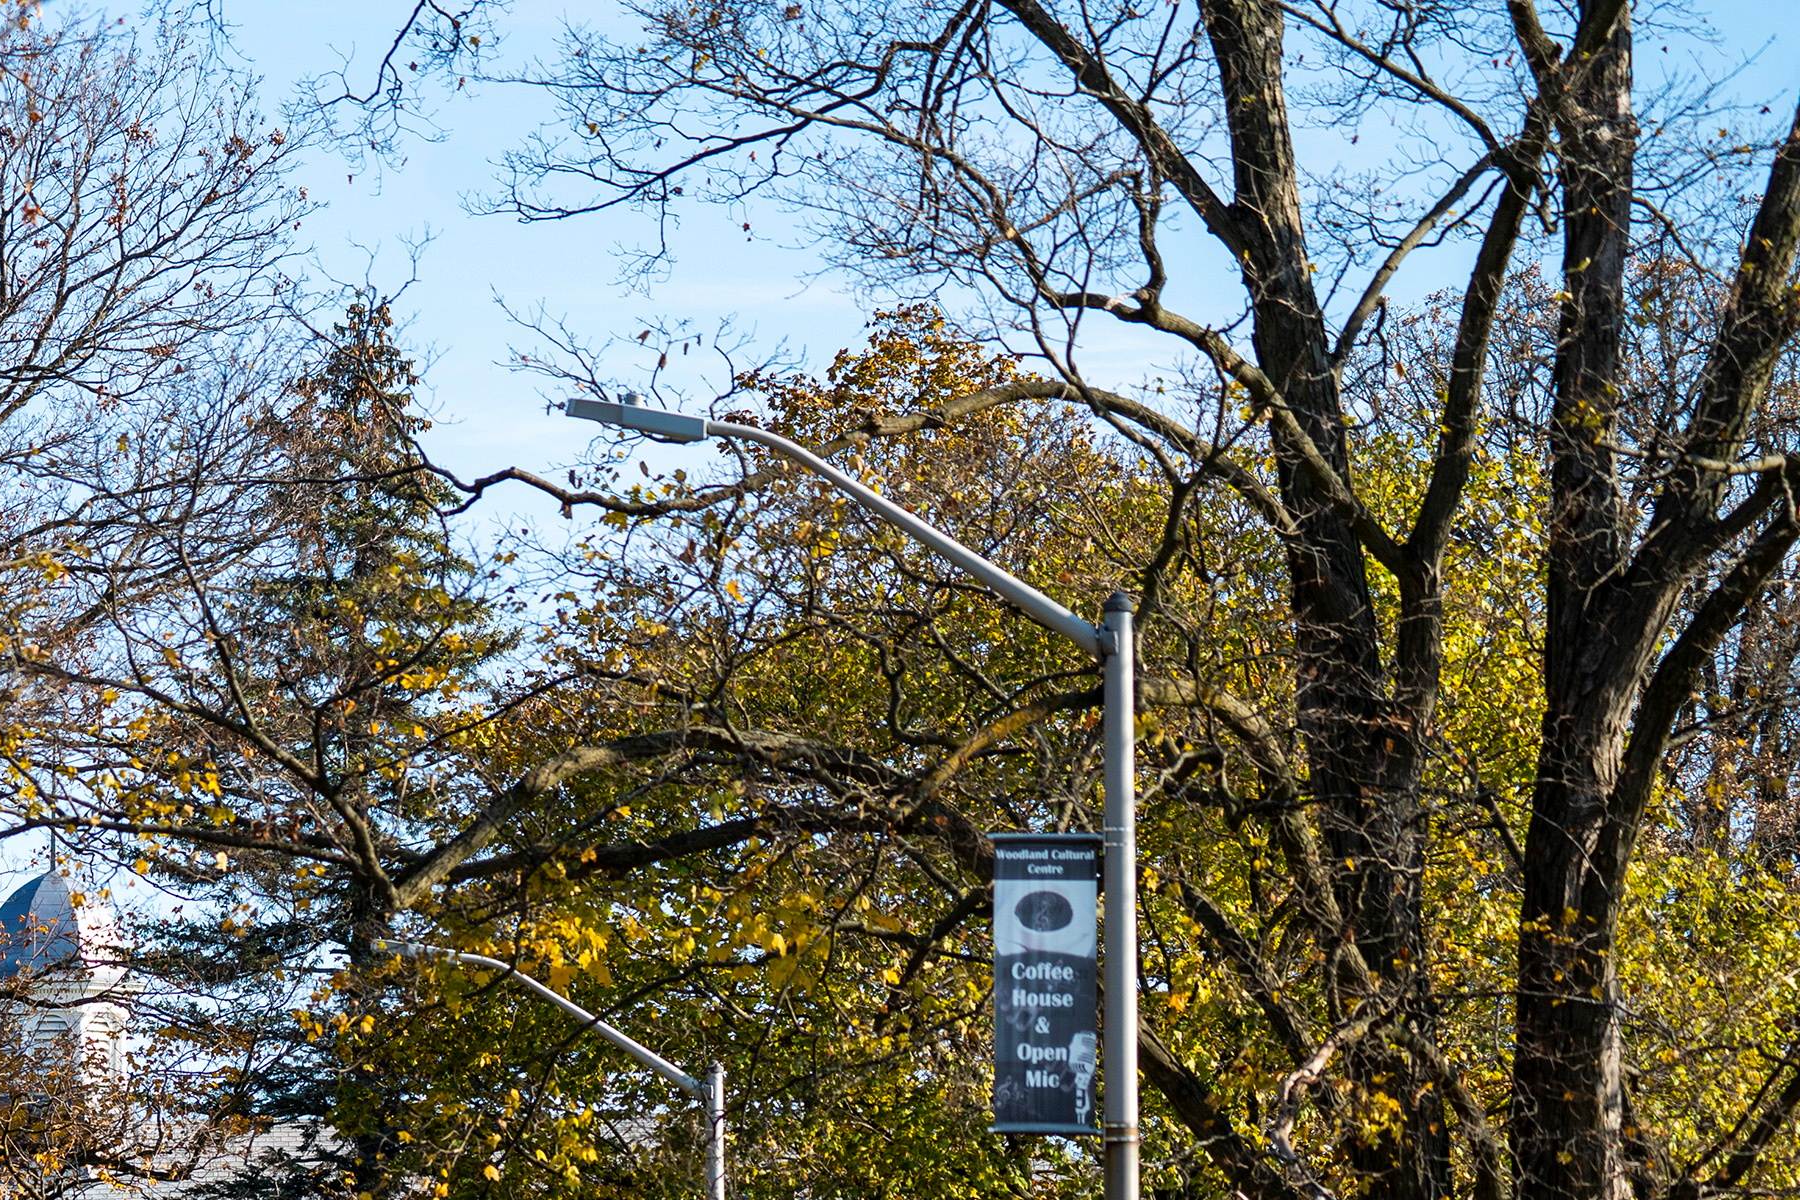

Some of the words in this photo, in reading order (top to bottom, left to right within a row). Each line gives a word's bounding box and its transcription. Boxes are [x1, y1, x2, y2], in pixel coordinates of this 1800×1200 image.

[995, 849, 1048, 860] Woodland
[1051, 849, 1095, 860] Cultural
[1027, 863, 1064, 874] Centre
[1011, 961, 1074, 980] Coffee
[1012, 988, 1074, 1008] House
[1034, 1016, 1050, 1034] &
[1017, 1042, 1067, 1064] Open
[1025, 1069, 1060, 1088] Mic
